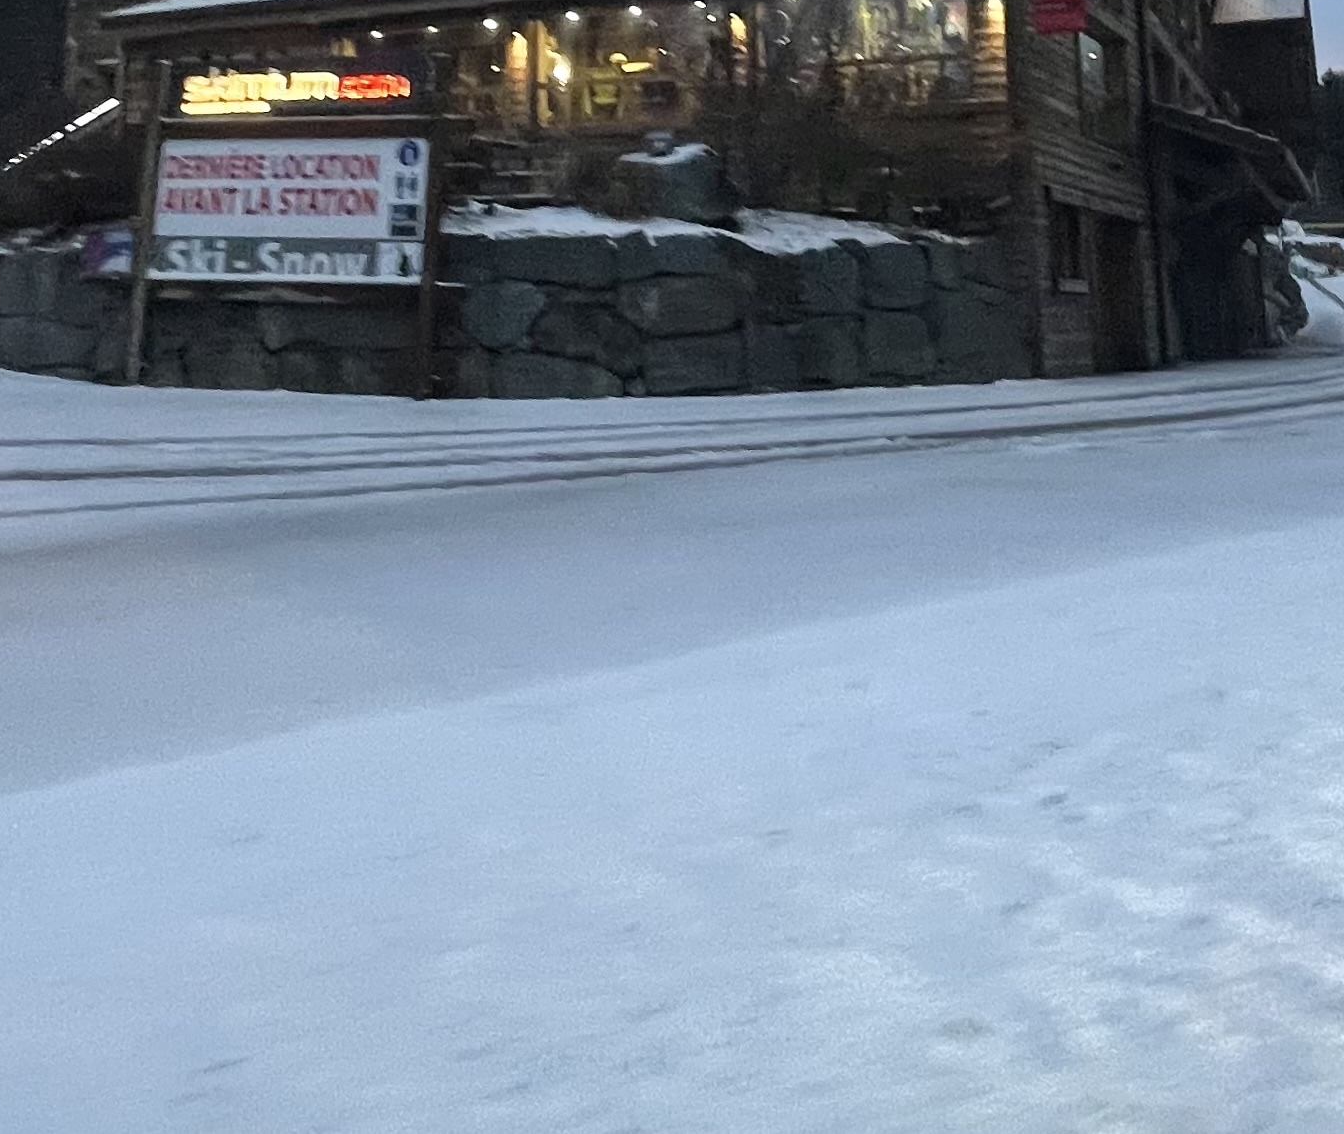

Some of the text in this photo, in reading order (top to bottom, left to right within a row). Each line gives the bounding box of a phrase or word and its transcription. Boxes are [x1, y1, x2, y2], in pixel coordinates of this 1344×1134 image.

[268, 153, 380, 181] LOCATION
[162, 187, 379, 216] AVANT LA STATION
[166, 238, 228, 274] Ski
[258, 241, 369, 276] Snow
